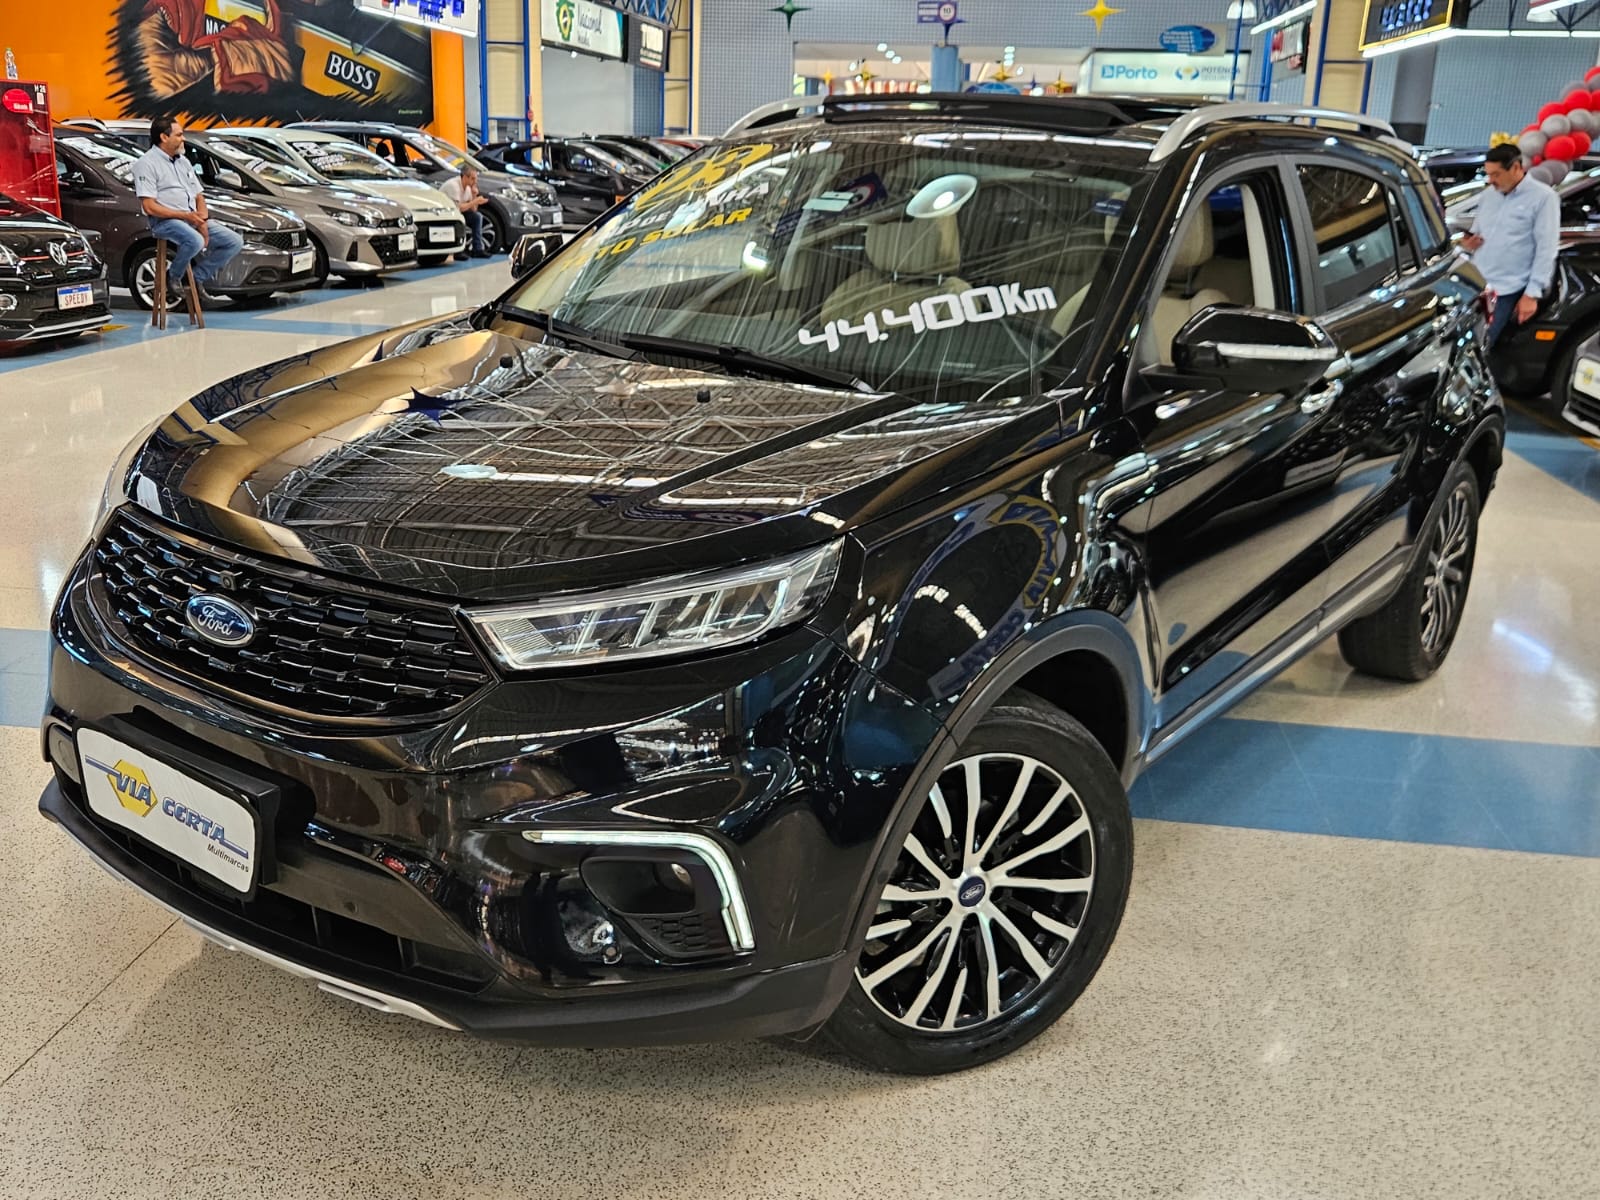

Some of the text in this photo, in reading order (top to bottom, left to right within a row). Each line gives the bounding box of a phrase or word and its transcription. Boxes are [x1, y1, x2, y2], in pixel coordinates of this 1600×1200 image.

[328, 53, 376, 91] BOSS
[1115, 65, 1158, 79] Porto
[640, 207, 752, 247] SOLAR
[798, 282, 1057, 352] 44.400Km
[197, 604, 233, 636] Ford
[114, 771, 225, 845] VIA CERTA
[207, 844, 249, 873] Multimarcas
